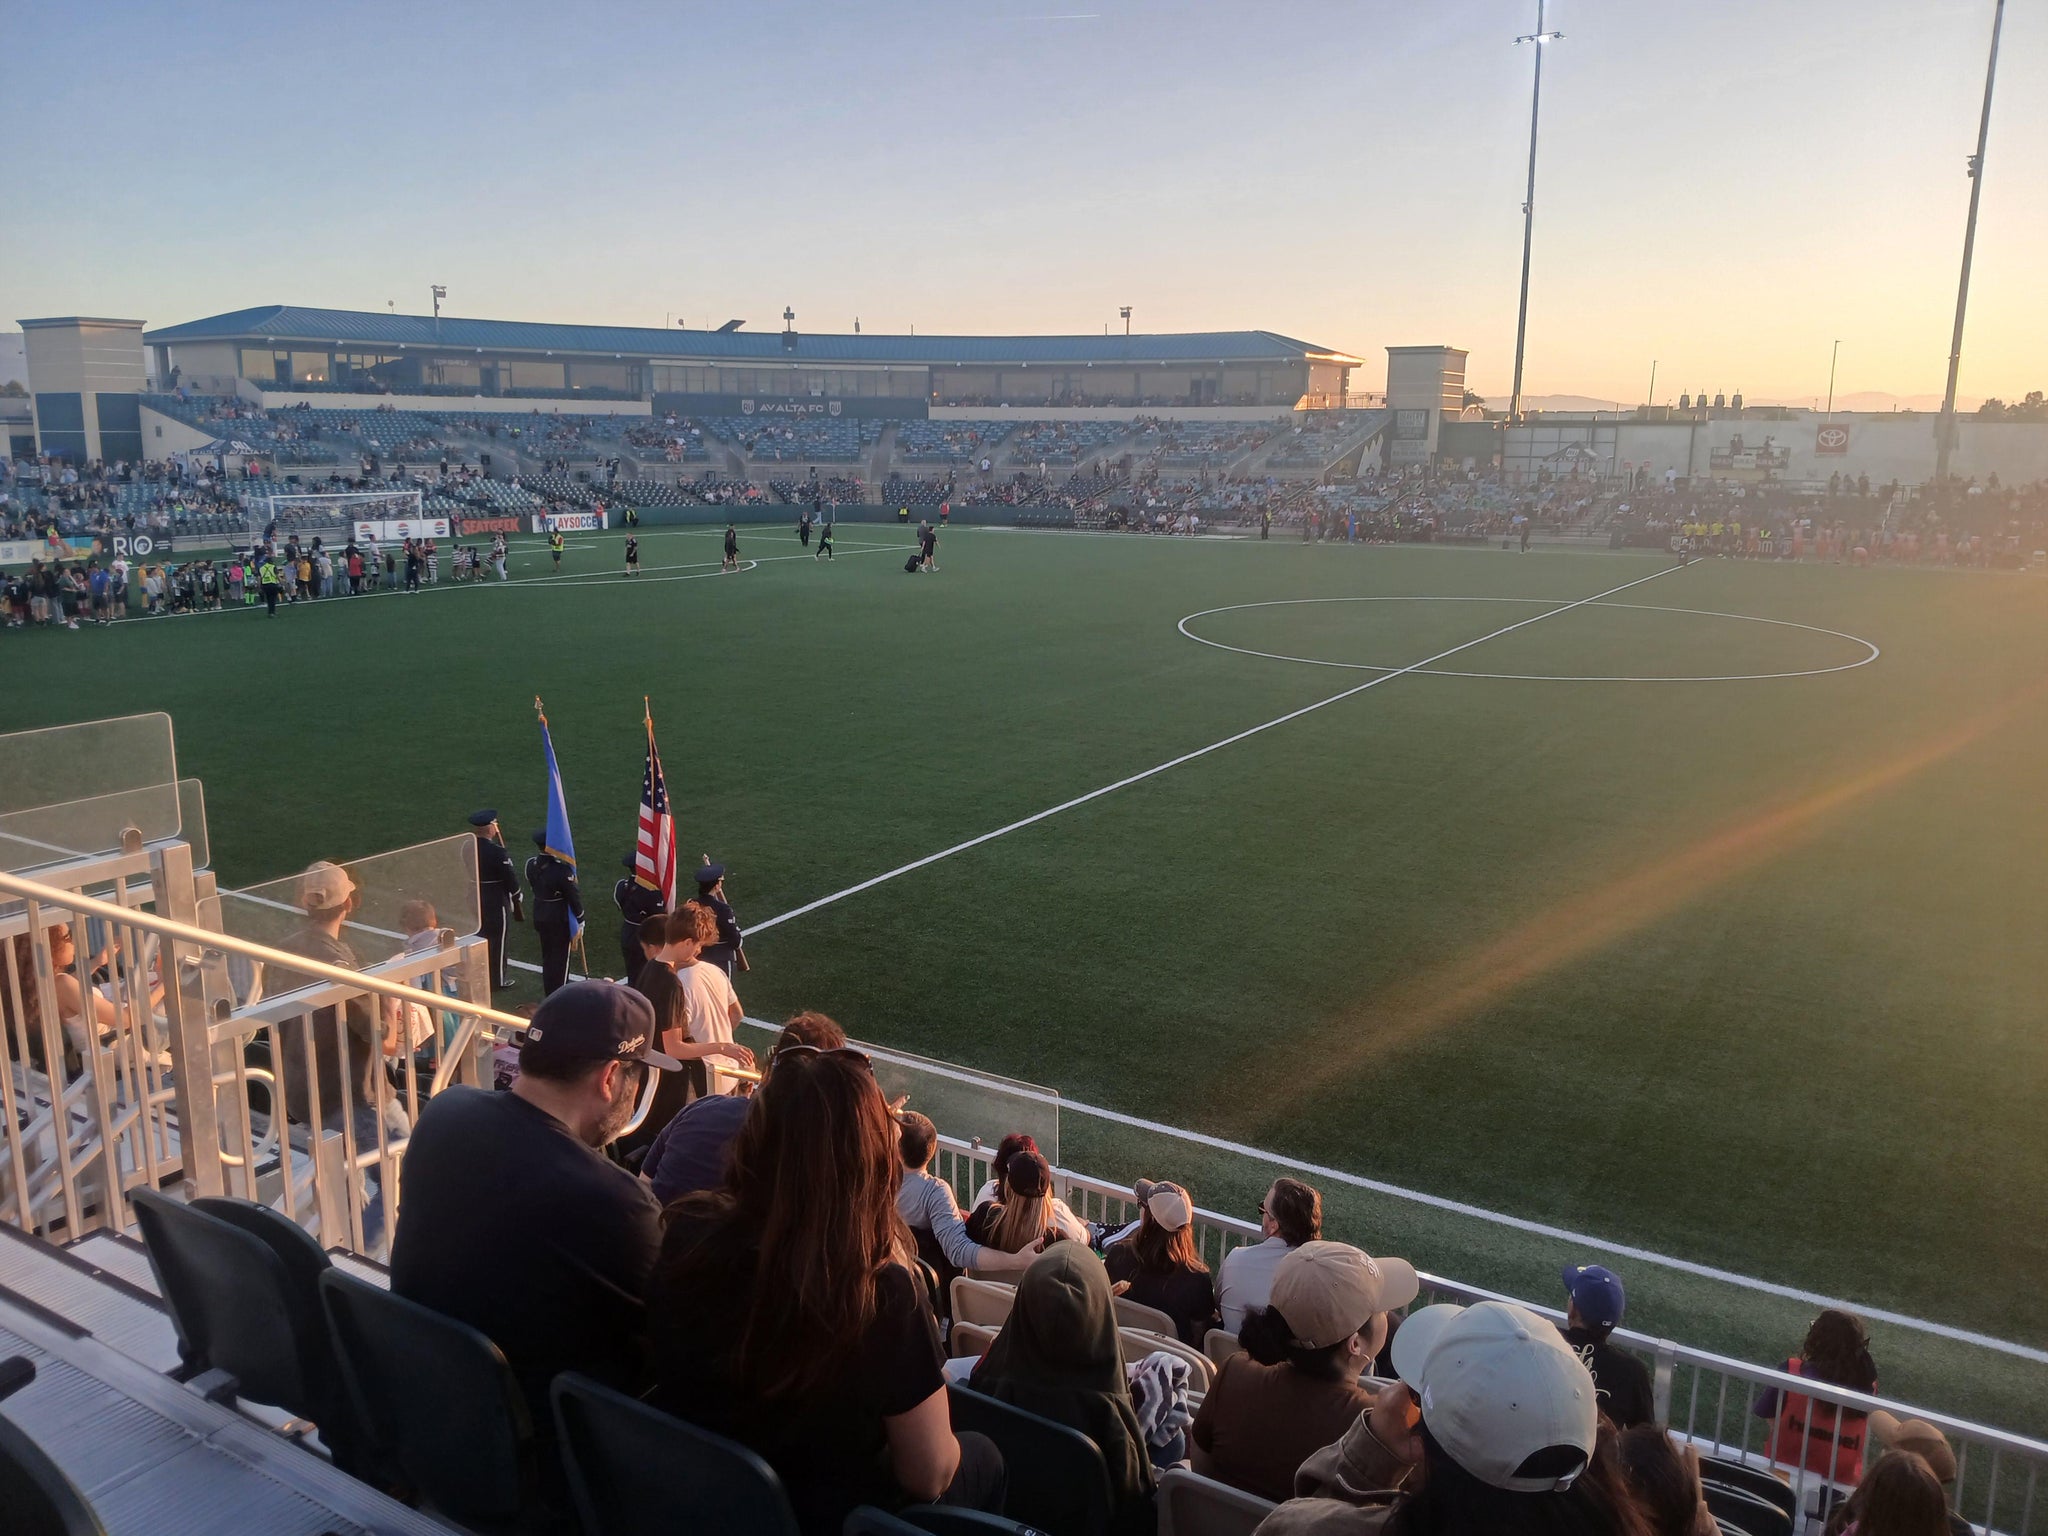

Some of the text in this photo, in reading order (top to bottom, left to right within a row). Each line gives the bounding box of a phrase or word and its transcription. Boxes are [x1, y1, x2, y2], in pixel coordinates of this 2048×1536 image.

[462, 517, 520, 535] SEATGEEK
[546, 515, 602, 529] PLAYSOCCE
[112, 535, 153, 557] RIO
